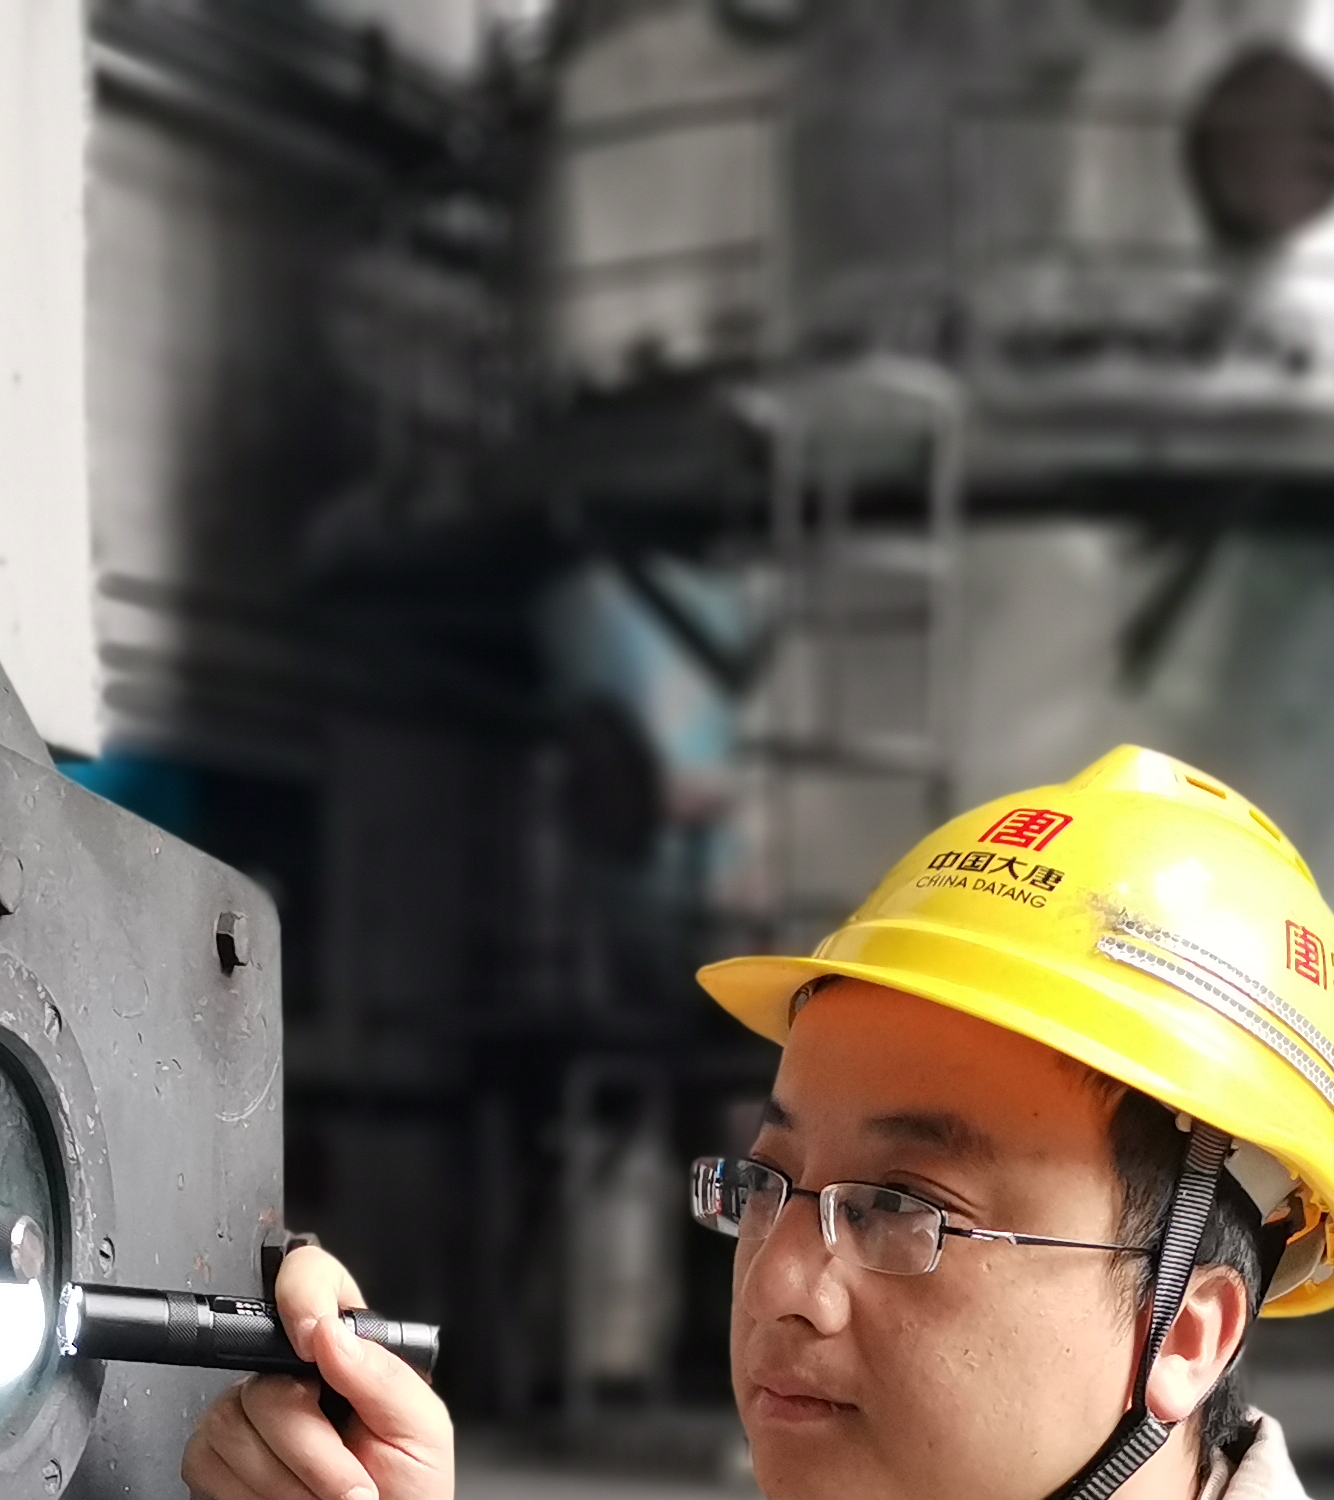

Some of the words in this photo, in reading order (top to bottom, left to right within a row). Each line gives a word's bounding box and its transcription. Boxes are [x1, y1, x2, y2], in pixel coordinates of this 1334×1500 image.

[926, 851, 1065, 892] 中国大唐
[916, 873, 968, 889] CHINA
[972, 878, 1047, 909] DATANG
